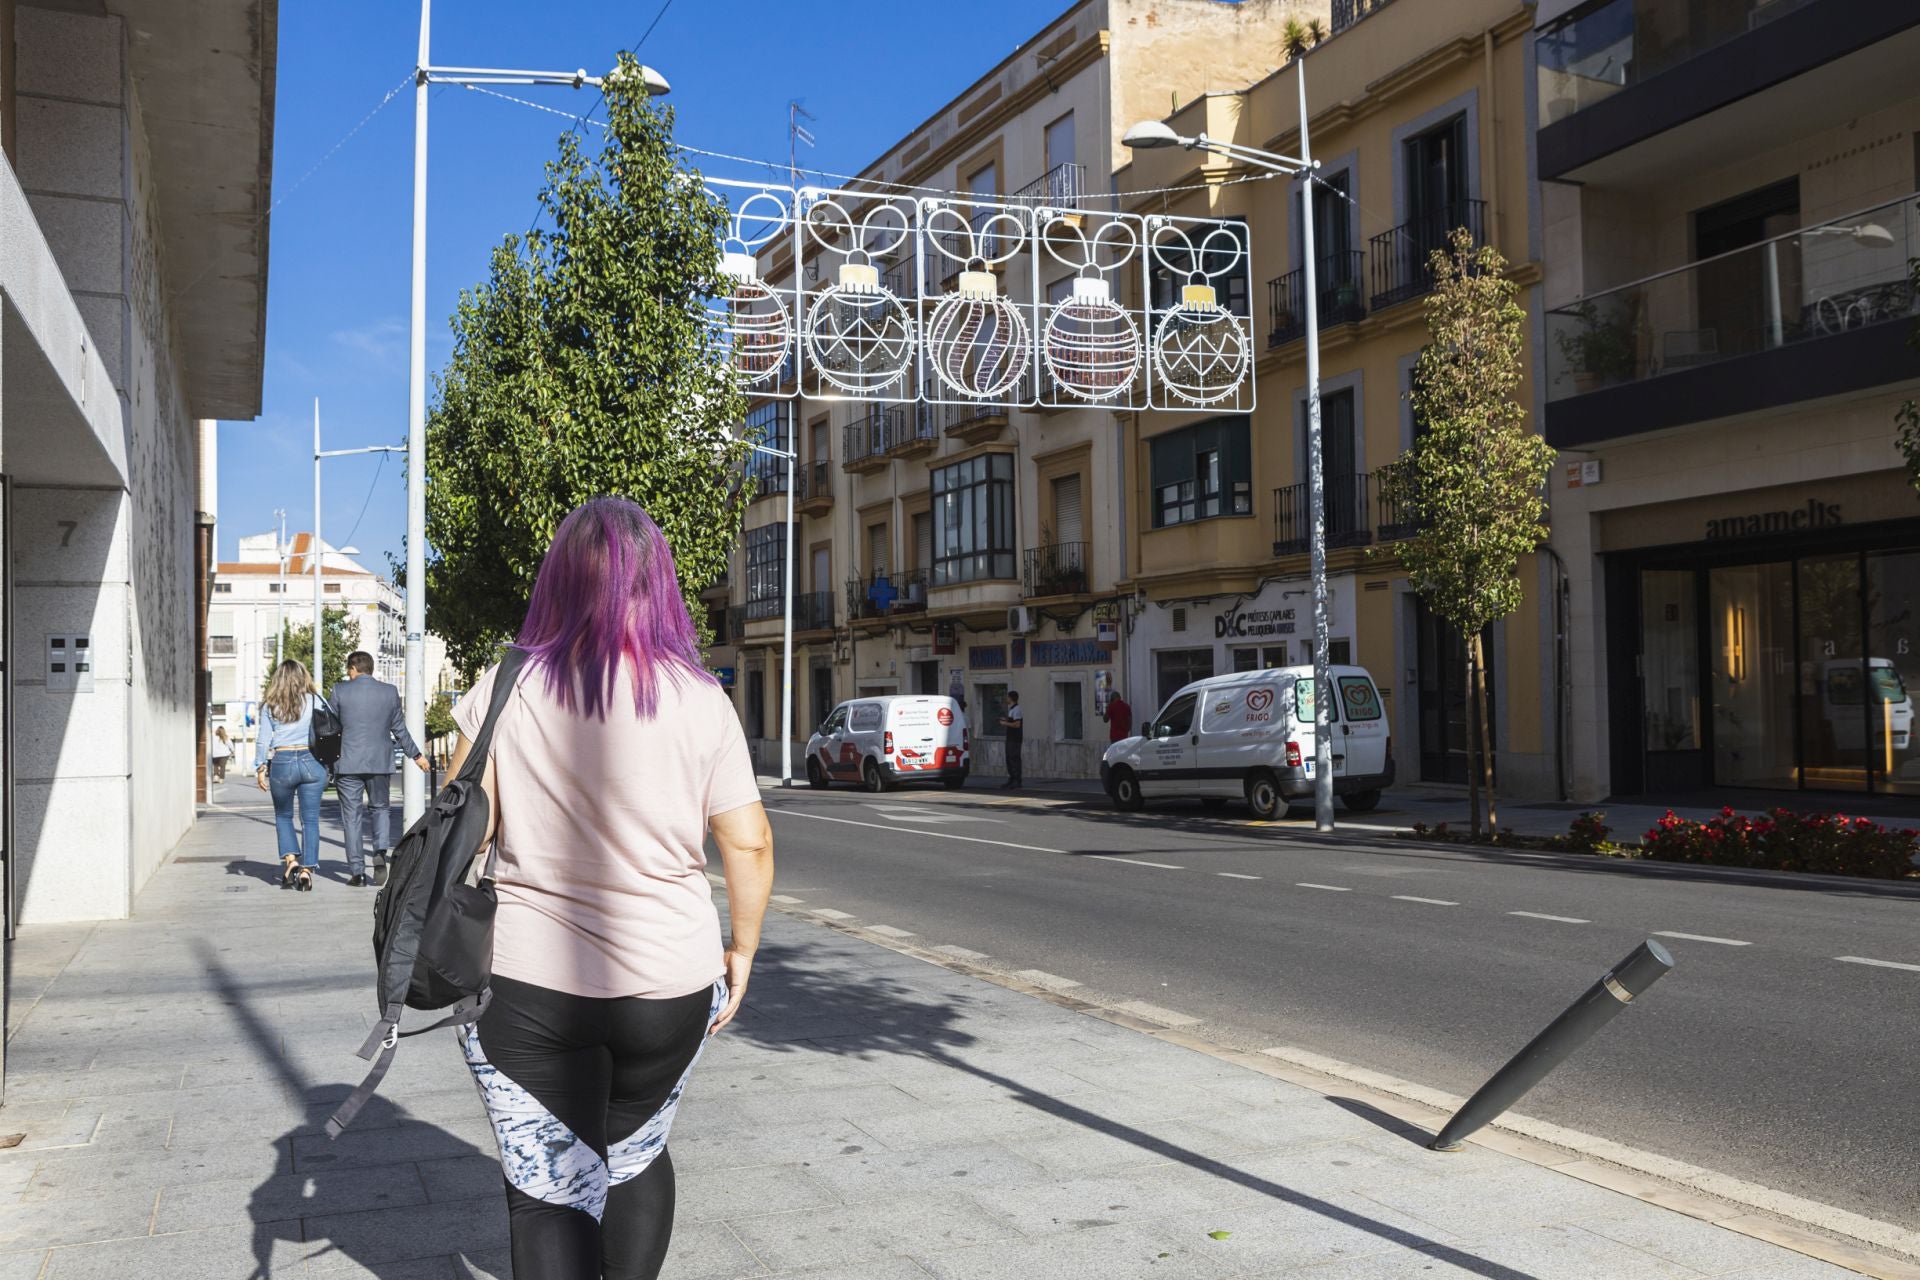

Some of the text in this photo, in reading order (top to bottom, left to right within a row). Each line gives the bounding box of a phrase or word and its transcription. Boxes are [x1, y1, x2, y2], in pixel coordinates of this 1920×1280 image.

[57, 520, 78, 547] 7
[1215, 613, 1247, 638] D&C
[1246, 712, 1269, 721] FRIGO
